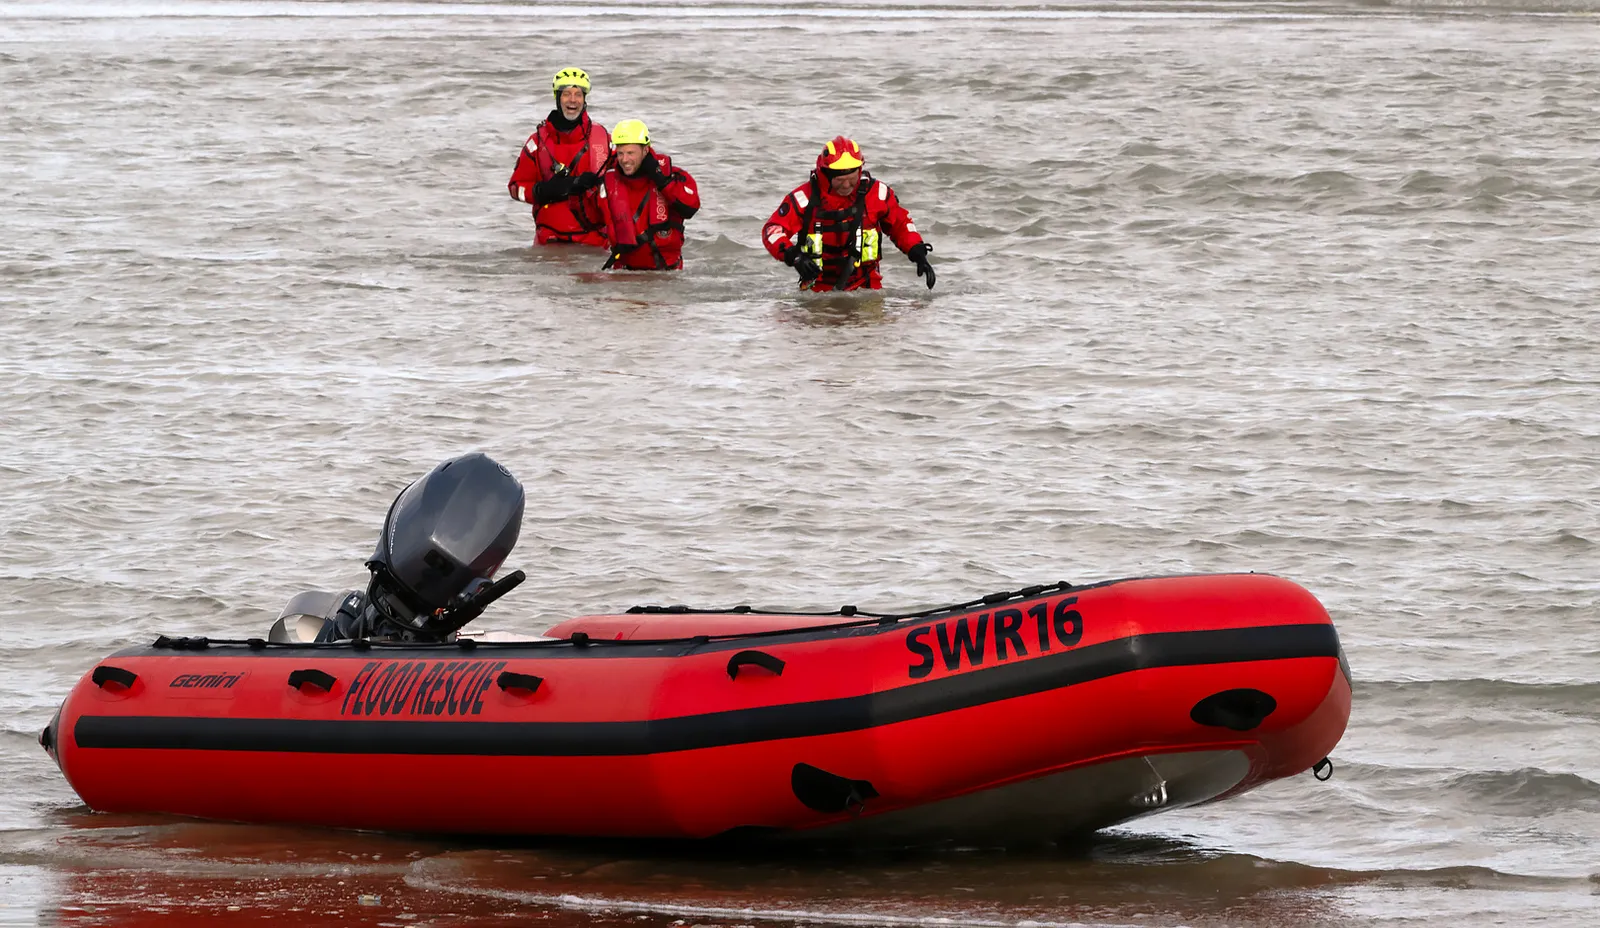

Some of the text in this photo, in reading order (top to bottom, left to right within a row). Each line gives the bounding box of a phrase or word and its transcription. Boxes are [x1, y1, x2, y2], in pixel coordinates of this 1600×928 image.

[906, 597, 1083, 678] SWR16
[341, 661, 506, 716] FLOOD RESCUE
